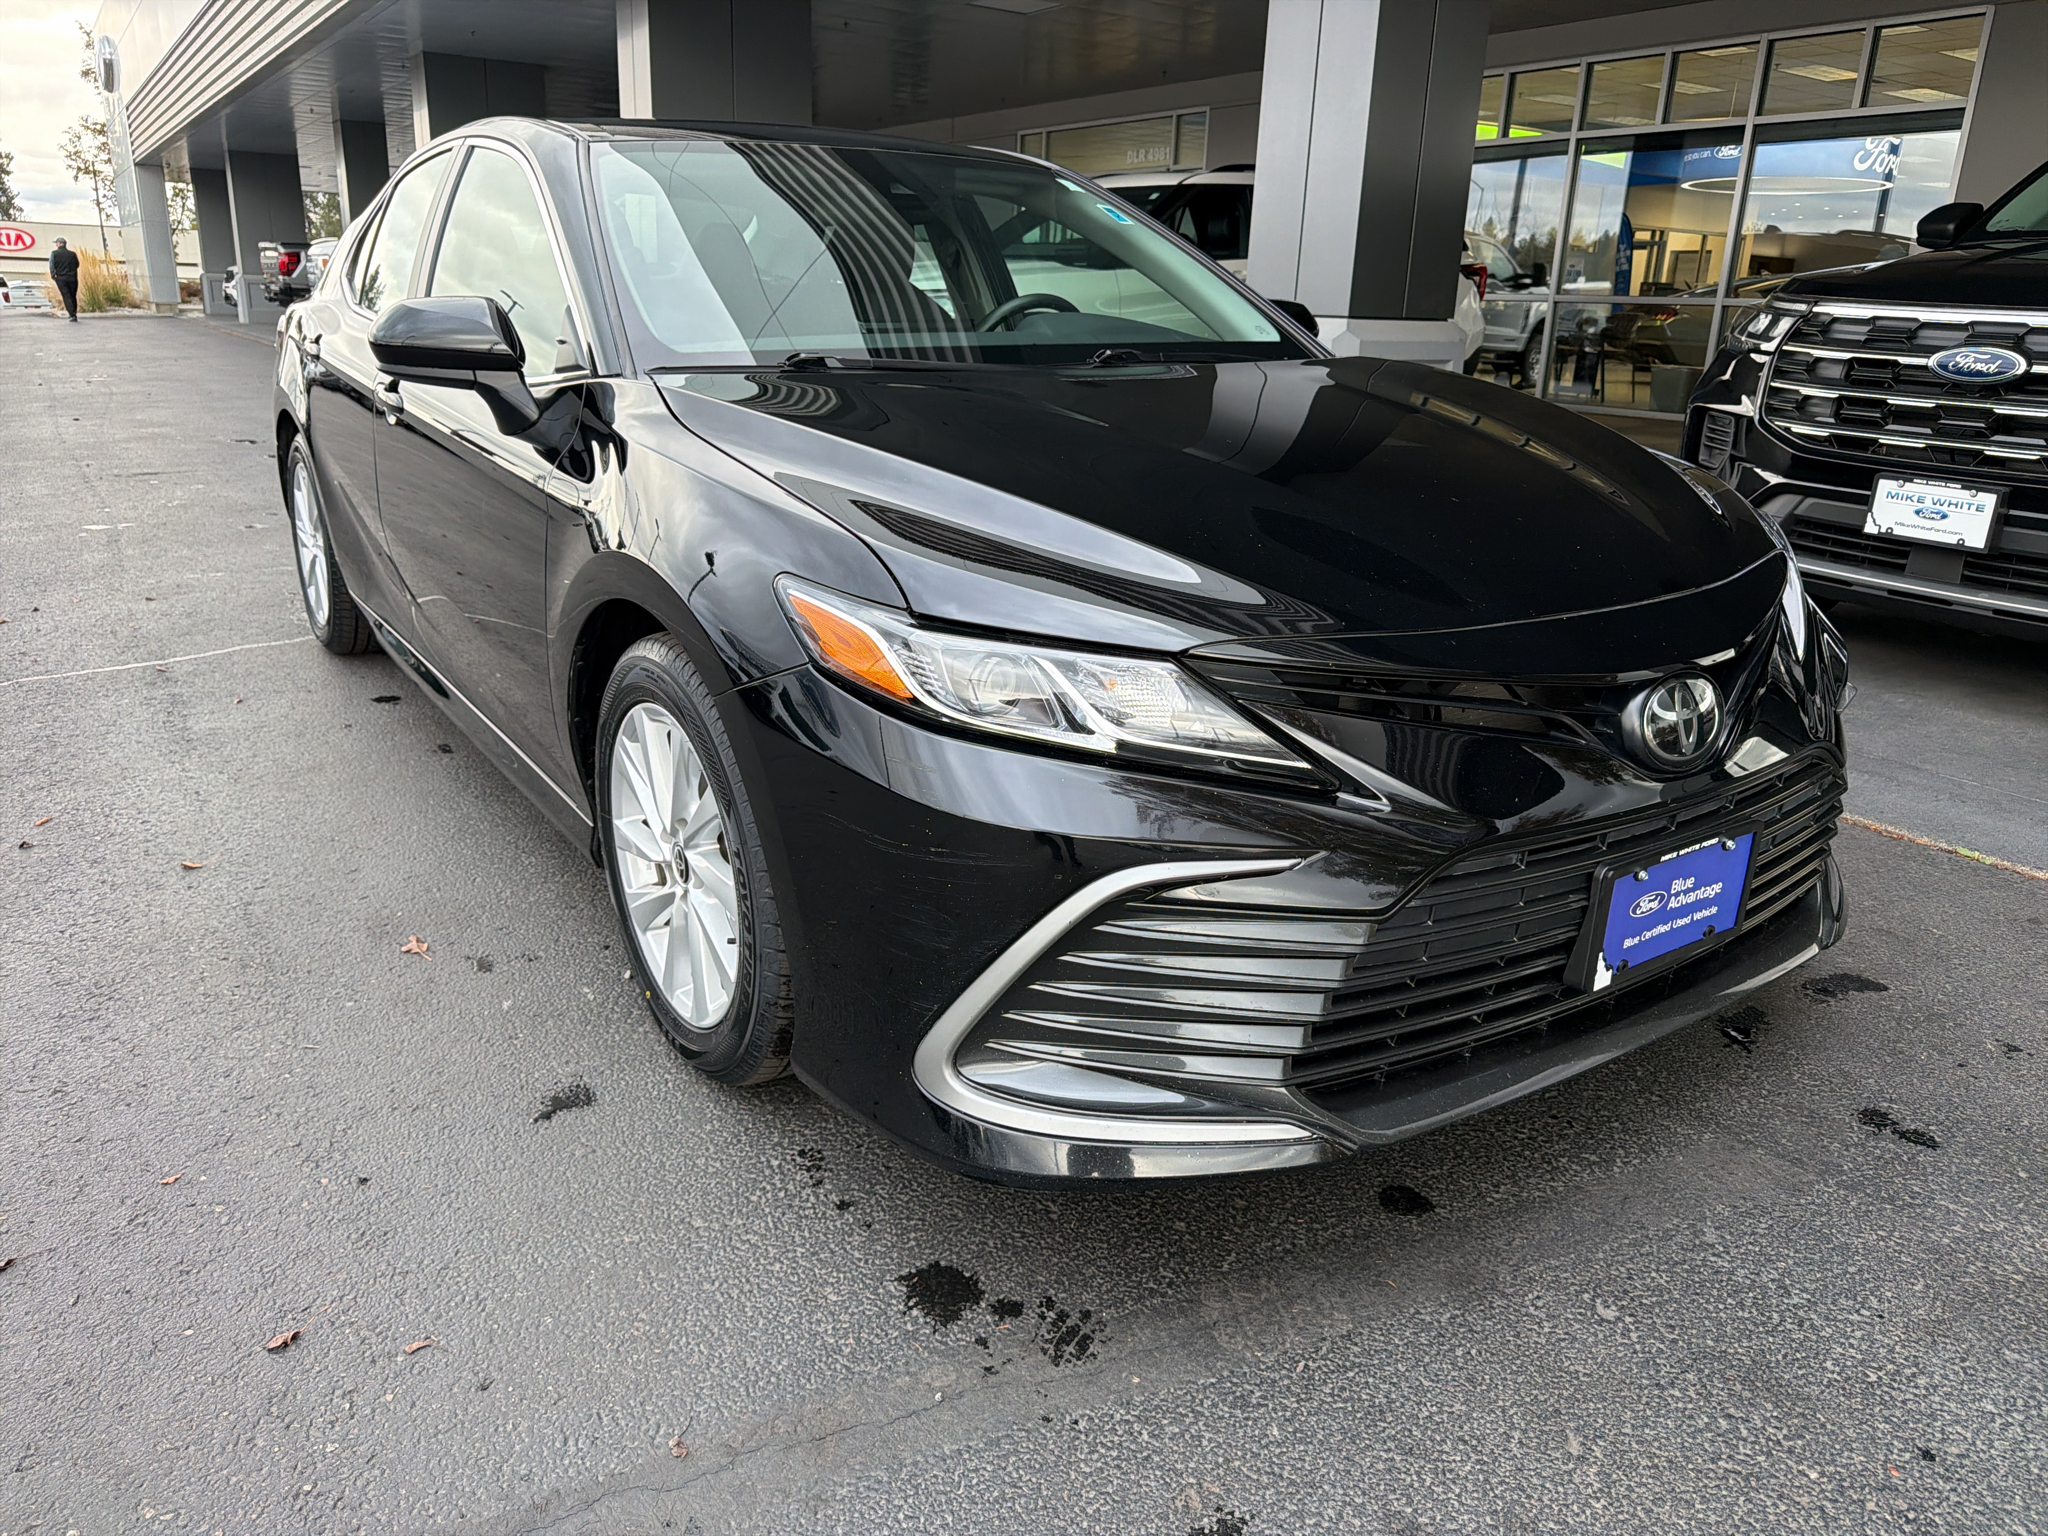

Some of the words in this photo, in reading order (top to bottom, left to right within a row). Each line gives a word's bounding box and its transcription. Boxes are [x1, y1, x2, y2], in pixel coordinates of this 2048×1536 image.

[1127, 148, 1146, 164] DLR
[1147, 146, 1170, 161] 4981
[1718, 145, 1741, 157] Ford
[1948, 352, 2002, 374] Ford
[1913, 478, 1927, 486] MIKE
[1946, 481, 1962, 489] FORD
[1885, 491, 1927, 504] MIKE
[1931, 496, 1987, 513] WHITE
[1918, 507, 1943, 520] Ford
[1894, 521, 1963, 536] MikeWhiteFord.com
[1660, 851, 1678, 863] MIKE
[1679, 843, 1701, 856] WHITE
[1701, 837, 1720, 849] FORD
[1670, 876, 1695, 894] Blue
[1636, 895, 1662, 915] Ford
[1667, 881, 1723, 911] Advantage
[1623, 937, 1640, 949] Blue
[1641, 920, 1671, 941] Certified
[1672, 913, 1691, 929] Used
[1693, 904, 1719, 922] Vehicle
